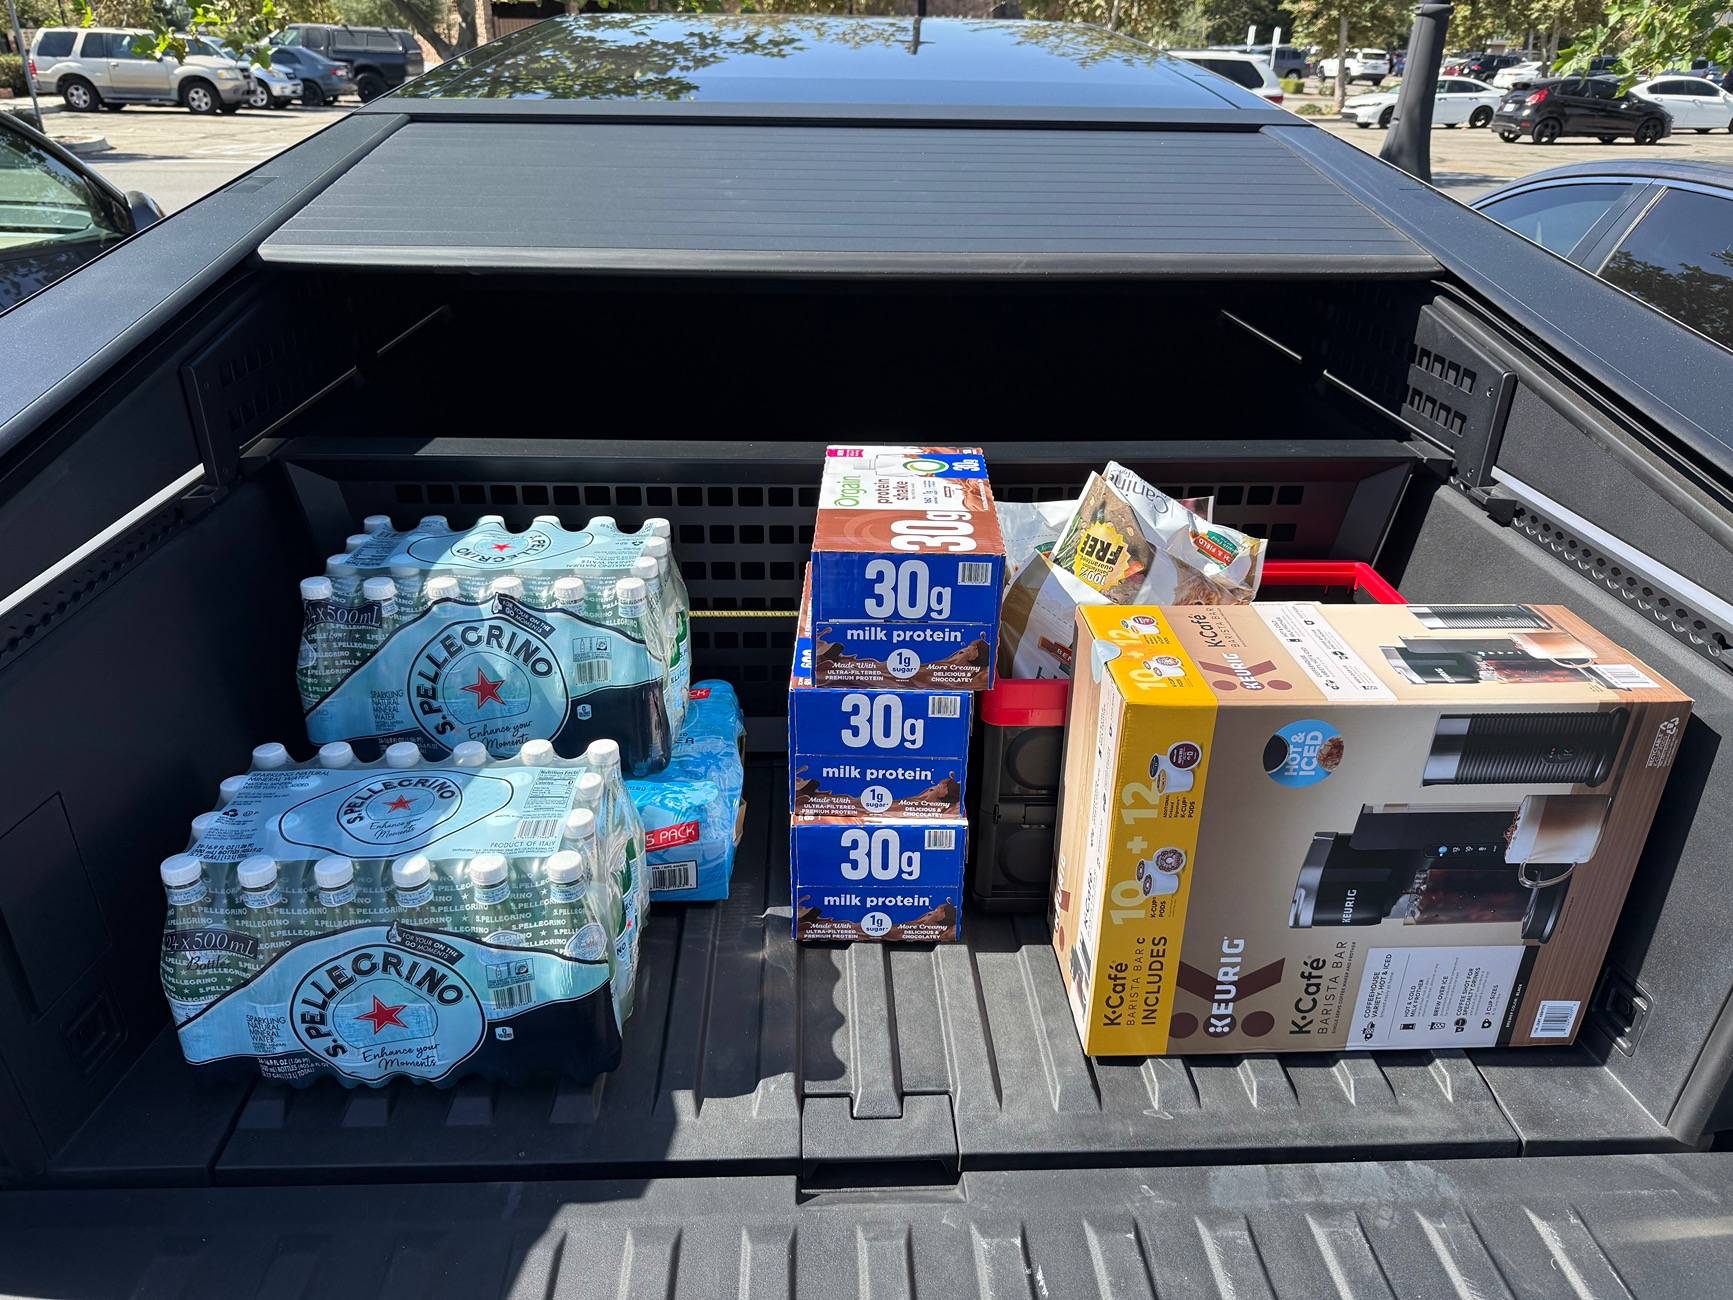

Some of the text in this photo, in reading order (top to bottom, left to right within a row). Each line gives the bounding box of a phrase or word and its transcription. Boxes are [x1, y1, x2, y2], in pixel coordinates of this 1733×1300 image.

[834, 475, 866, 507] Orgain
[875, 478, 893, 504] protein
[892, 481, 909, 501] shake
[890, 511, 977, 552] 30g
[1080, 533, 1124, 565] FREE
[1078, 567, 1106, 586] 100%
[865, 559, 951, 619] 30g
[530, 618, 541, 626] ON
[847, 629, 962, 643] milk protein
[898, 653, 910, 667] 1g
[949, 664, 980, 673] Creamy
[1222, 652, 1262, 689] KEURIG
[416, 624, 554, 736] S.PELLEGRINO
[468, 720, 534, 740] Enhance your
[841, 693, 924, 749] 30g
[1284, 731, 1306, 775] HOT &
[1299, 731, 1323, 776] ICED
[822, 766, 932, 781] milk protein
[343, 778, 456, 825] S.PELLEGRINO
[870, 790, 883, 802] 1g
[921, 800, 950, 809] Creamy
[1188, 801, 1196, 818] PODS
[660, 824, 695, 844] PACK
[840, 828, 921, 880] 30g
[1109, 782, 1160, 925] 10 + 12
[824, 895, 930, 908] milk protein
[1158, 900, 1167, 918] PODS
[1342, 889, 1357, 924] KEURIG
[870, 915, 883, 927] 1g
[919, 923, 948, 932] Creamy
[402, 932, 459, 957] FOR YOUR ON THE
[405, 940, 450, 959] GO MOMENTS
[1133, 949, 1145, 971] BAR
[1141, 936, 1168, 1025] INCLUDES
[1208, 937, 1245, 1033] KEURIG
[1317, 942, 1347, 1034] BARISTA BAR
[1372, 991, 1383, 1018] VARIETY,
[1378, 976, 1386, 990] HOT
[1383, 953, 1392, 970] ICED
[1413, 979, 1424, 1004] FROTHER
[1462, 967, 1481, 1016] SPECIALTY DRINKS
[1490, 984, 1499, 1000] SIZES
[301, 950, 464, 1058] S.PELLEGRINO
[1127, 977, 1141, 1026] BARISTA
[1363, 972, 1380, 1018] COFFEEHOUSE
[1408, 985, 1416, 1000] COLD
[1432, 1001, 1441, 1017] BREW
[1437, 986, 1445, 1000] OVER
[1456, 996, 1466, 1016] COFFEE
[1463, 980, 1471, 995] SHOT
[246, 1014, 287, 1024] SPARKLING
[247, 1020, 281, 1031] NATURAL
[249, 1028, 281, 1038] MINERAL
[250, 1034, 275, 1043] WATER
[362, 1042, 440, 1063] Enhance your
[378, 1057, 437, 1071] Moments
